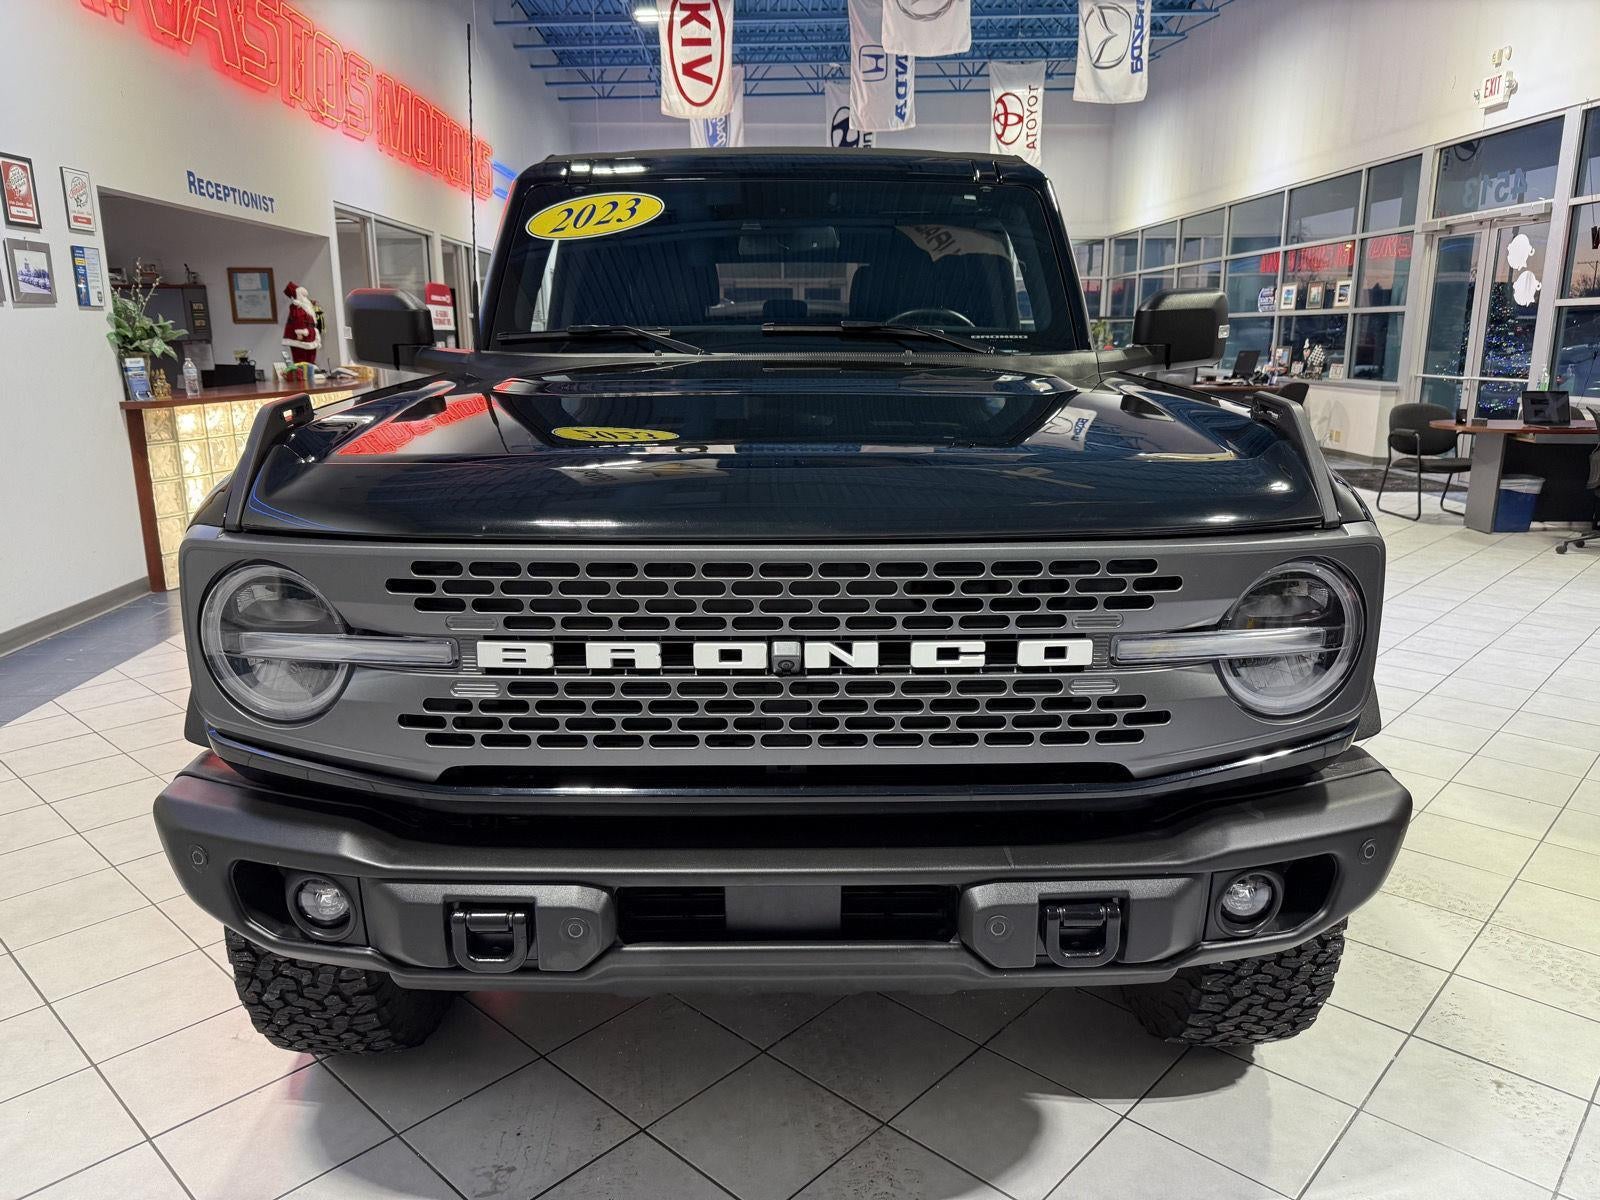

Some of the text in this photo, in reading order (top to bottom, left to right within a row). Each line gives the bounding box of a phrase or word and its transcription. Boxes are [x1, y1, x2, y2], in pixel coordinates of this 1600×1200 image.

[80, 0, 493, 200] ASTOS MOTORS
[1483, 75, 1502, 98] EXIT
[186, 170, 275, 213] RECEPTIONIST
[548, 197, 642, 234] 2023
[477, 638, 1093, 670] BRONCO
